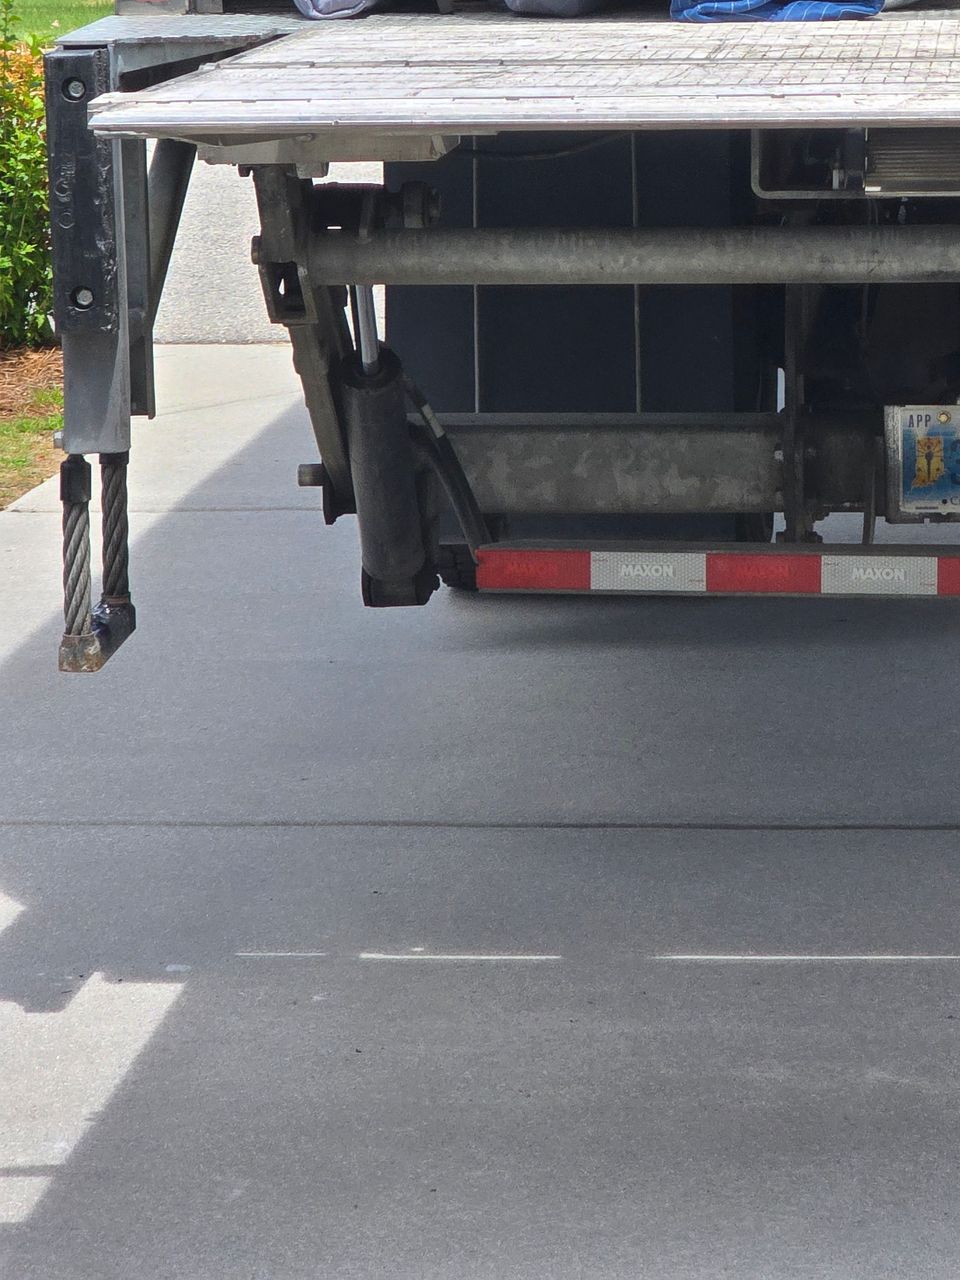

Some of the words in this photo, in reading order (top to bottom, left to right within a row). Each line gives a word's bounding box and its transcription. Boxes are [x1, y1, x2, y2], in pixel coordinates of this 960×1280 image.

[908, 414, 932, 428] APP
[621, 564, 674, 577] MAXON
[852, 568, 905, 581] MAXON
